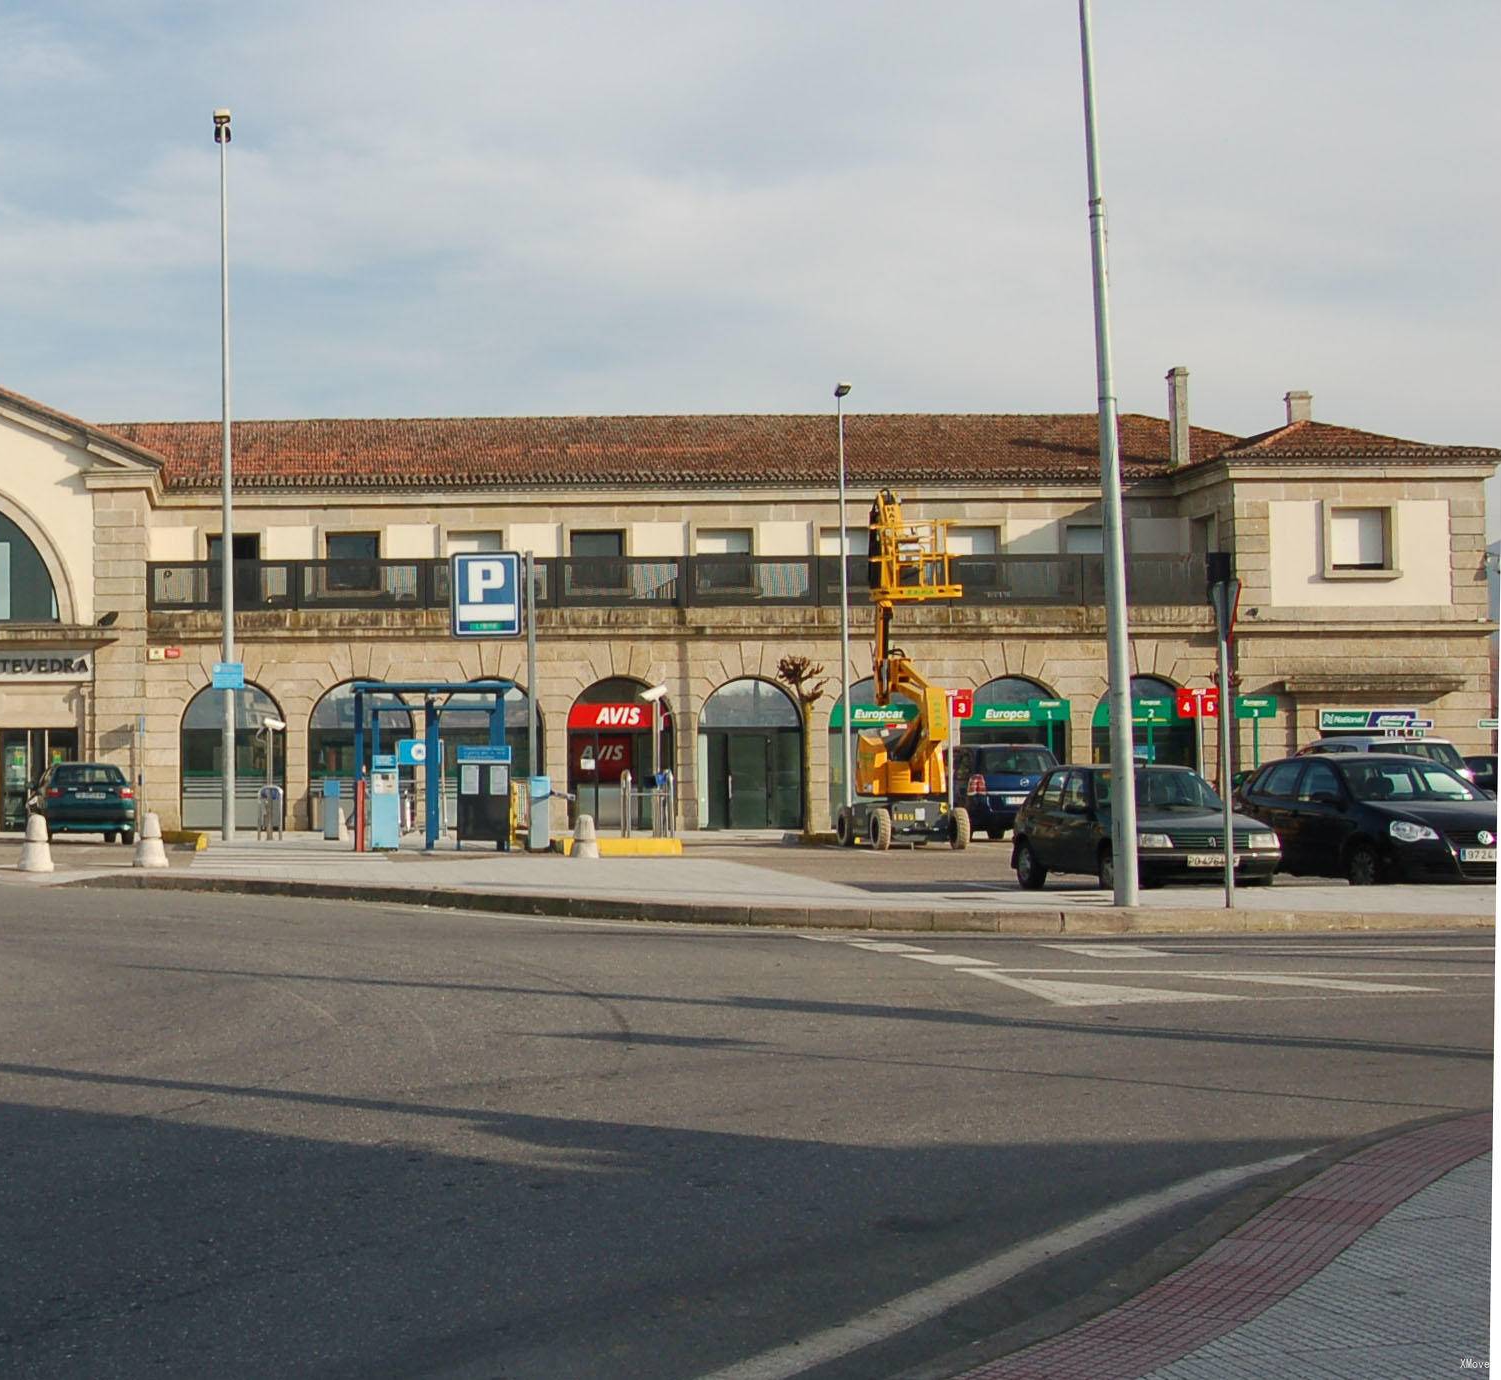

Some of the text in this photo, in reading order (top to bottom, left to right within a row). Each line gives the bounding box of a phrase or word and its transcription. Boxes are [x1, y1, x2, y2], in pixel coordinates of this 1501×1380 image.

[467, 560, 505, 603] P
[957, 702, 966, 714] 3
[1182, 701, 1191, 713] 4
[595, 706, 641, 726] AVIS
[854, 708, 904, 721] Europcar
[1147, 708, 1155, 719] 2
